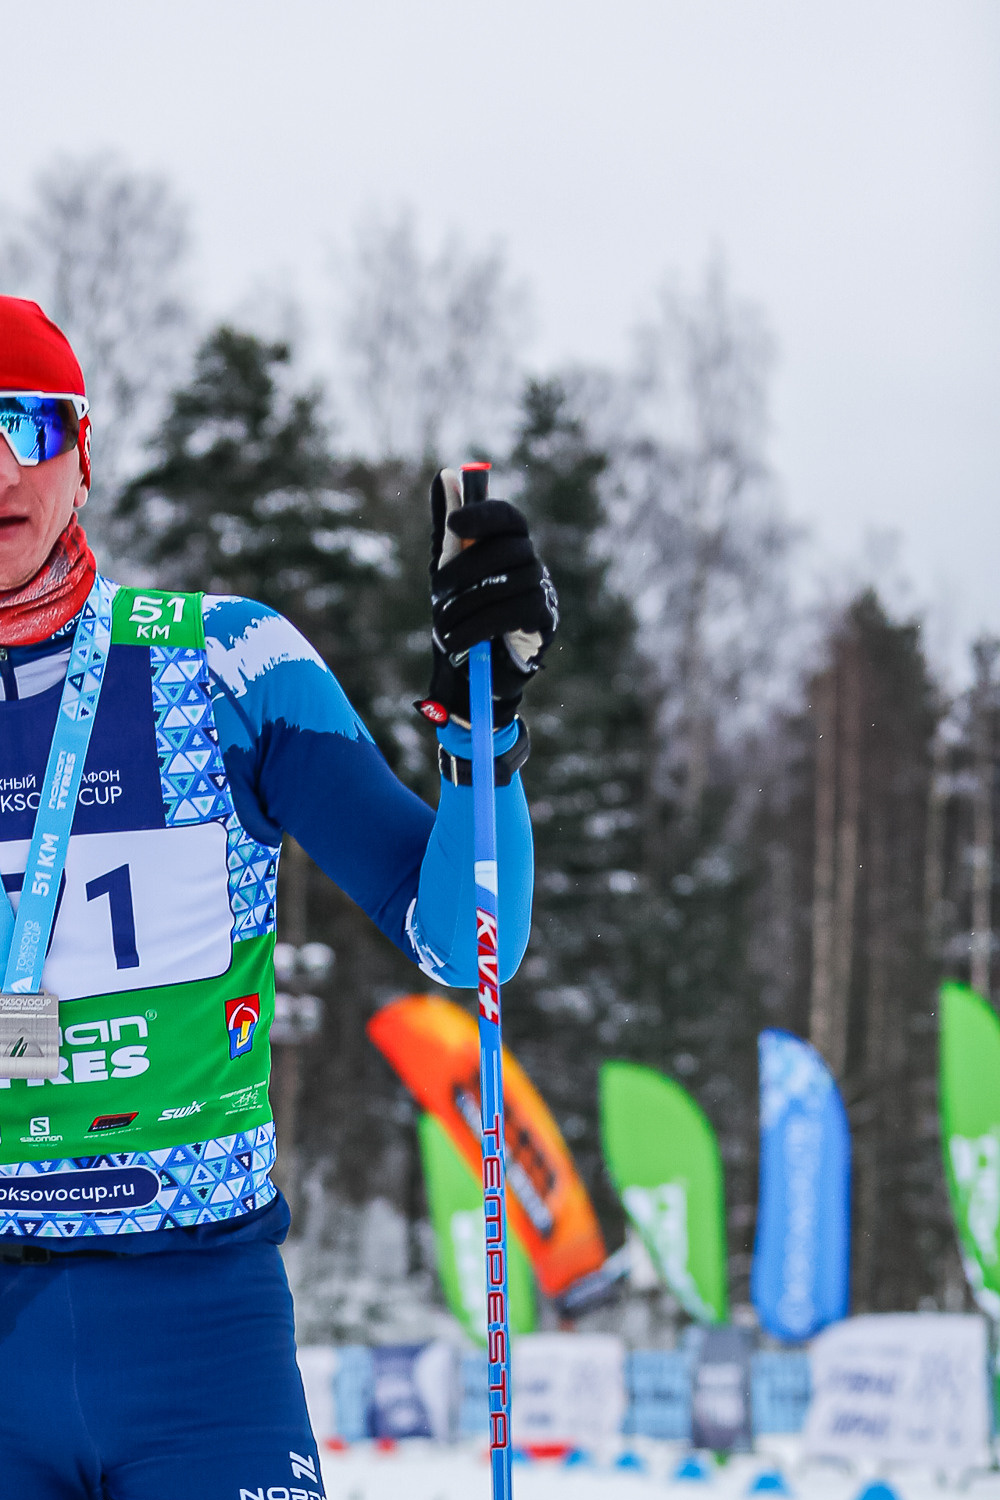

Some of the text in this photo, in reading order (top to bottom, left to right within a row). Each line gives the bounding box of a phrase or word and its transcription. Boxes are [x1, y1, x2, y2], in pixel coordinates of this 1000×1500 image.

[129, 595, 186, 624] 51
[81, 769, 121, 784] АФОН
[31, 871, 53, 897] 51
[482, 1113, 510, 1451] TEMPESTA
